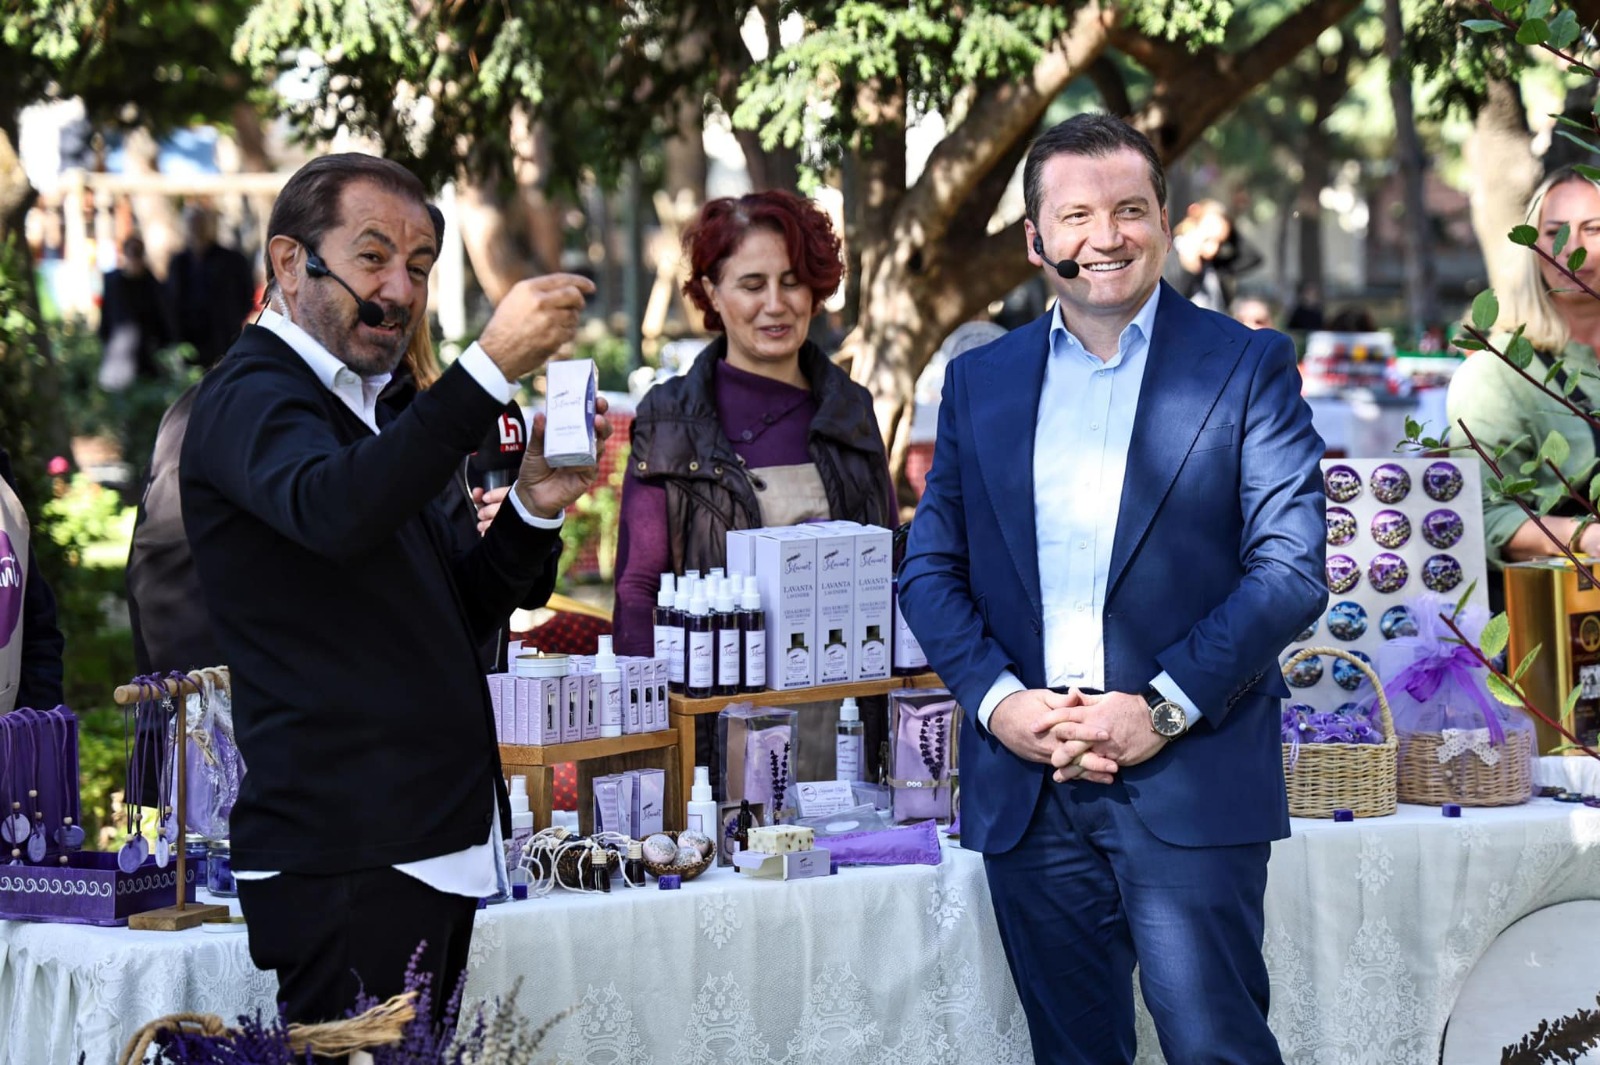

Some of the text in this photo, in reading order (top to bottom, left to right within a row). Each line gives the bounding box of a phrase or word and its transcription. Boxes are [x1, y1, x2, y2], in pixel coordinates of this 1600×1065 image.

[821, 581, 851, 590] LAVANTA
[858, 577, 889, 587] LAVANTA
[783, 584, 813, 594] LAVANTA
